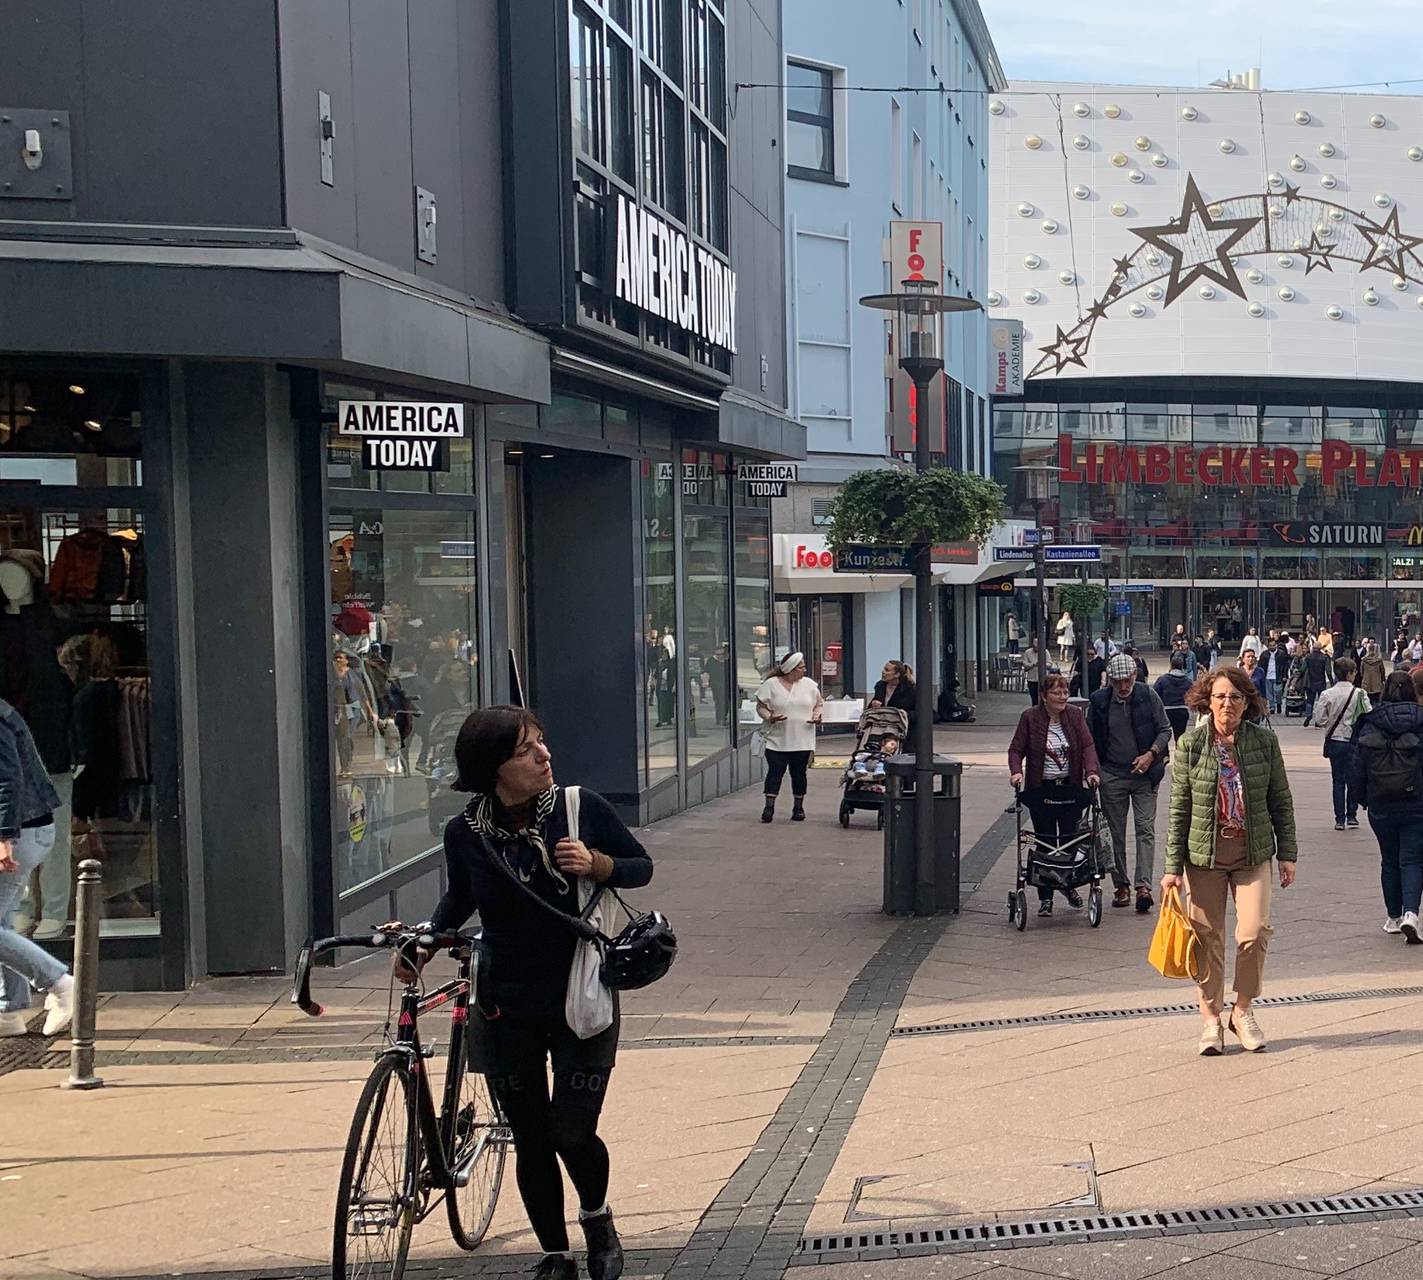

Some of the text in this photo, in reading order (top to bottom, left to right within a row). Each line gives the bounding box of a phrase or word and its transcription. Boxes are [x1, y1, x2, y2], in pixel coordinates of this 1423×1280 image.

[616, 194, 738, 354] AMERICA TODAY
[996, 352, 1007, 392] Kamps
[1011, 333, 1021, 386] AKADEMIE
[344, 405, 459, 433] AMERICA
[367, 440, 437, 467] TODAY
[1058, 433, 1301, 486] LIMBECKER
[739, 466, 793, 480] AMERICA
[750, 483, 783, 496] TODAY
[1309, 525, 1383, 544] SATURN
[1000, 551, 1034, 559] Lindenallee
[1046, 548, 1096, 558] Kastanienallee
